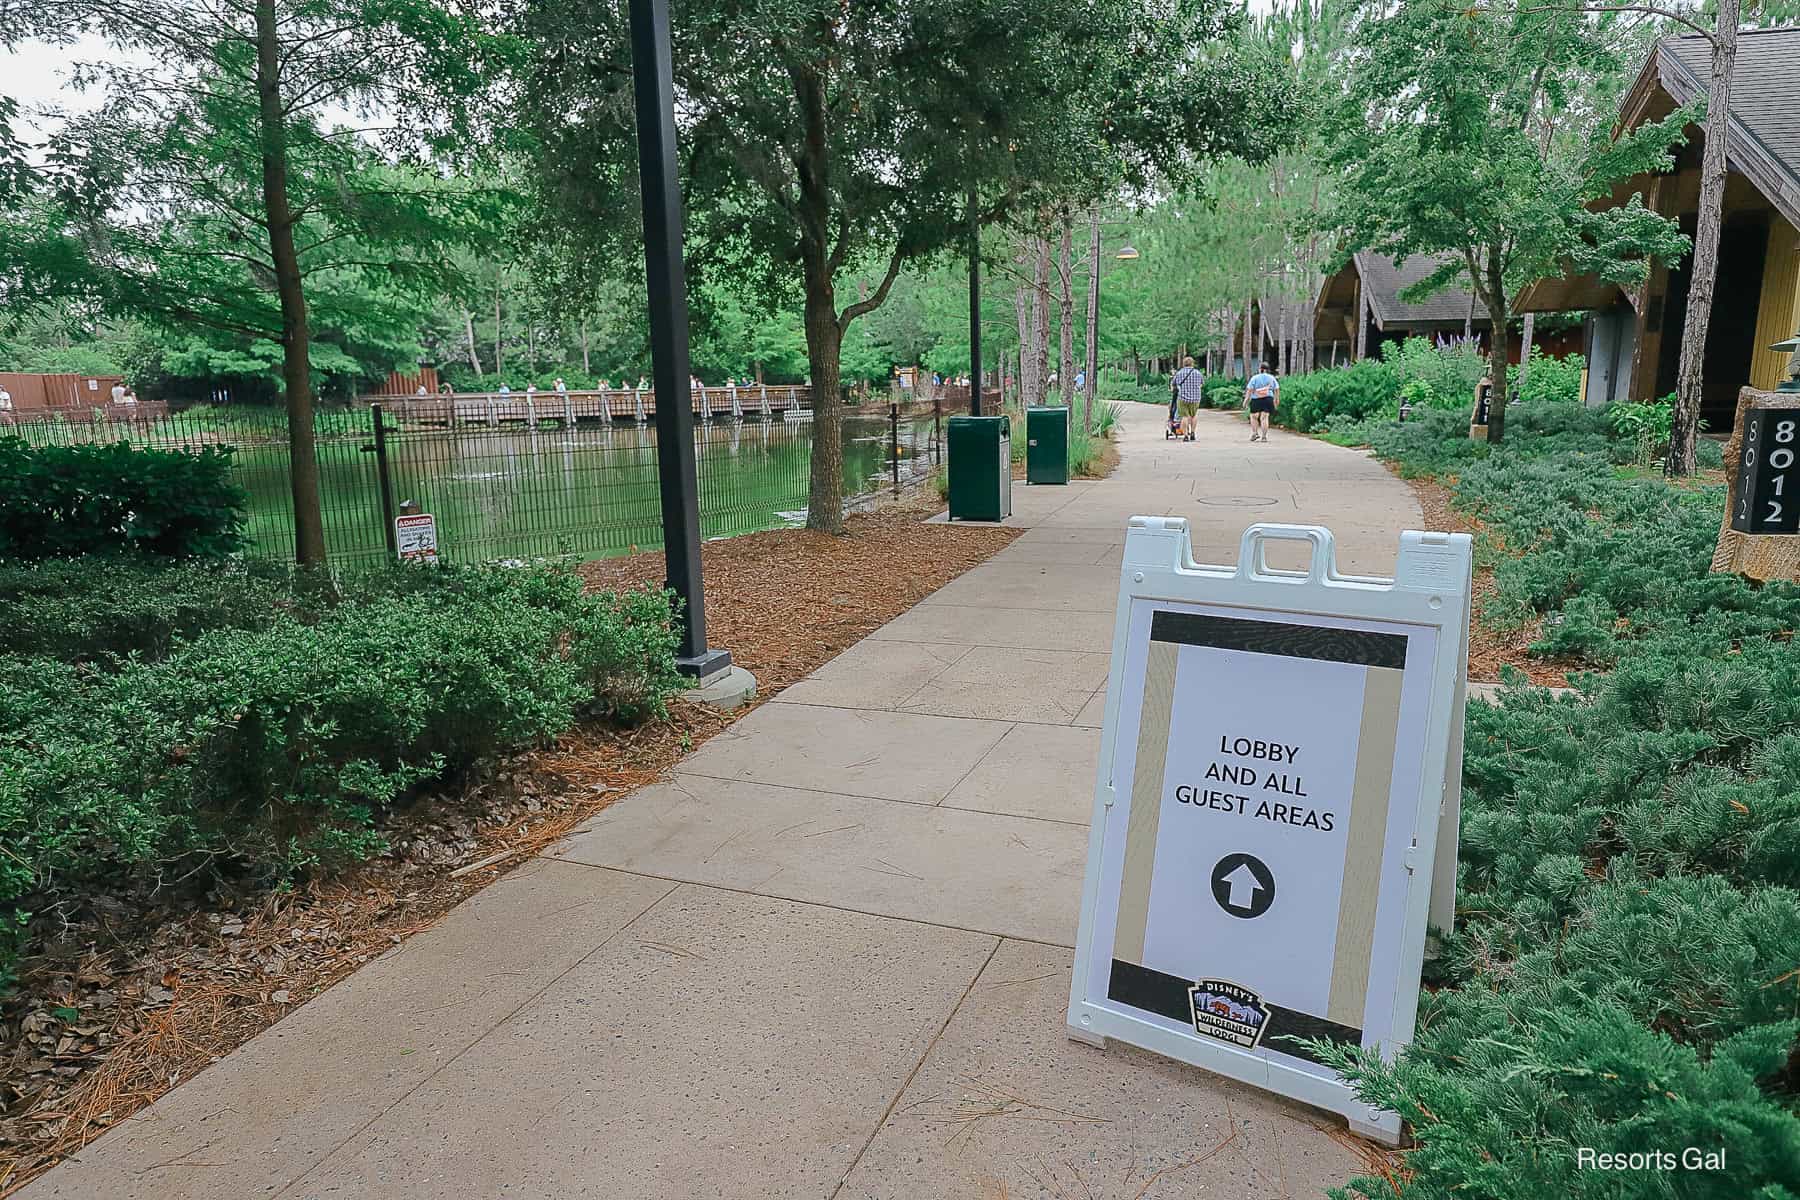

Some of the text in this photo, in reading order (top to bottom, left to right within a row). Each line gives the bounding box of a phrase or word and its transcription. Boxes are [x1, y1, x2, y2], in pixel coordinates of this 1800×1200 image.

[1763, 420, 1795, 522] 8012
[405, 518, 432, 526] DANGER
[1220, 735, 1299, 764] LOBBY
[1205, 762, 1307, 797] AND ALL
[1176, 785, 1334, 832] GUEST AREAS
[1207, 983, 1254, 1002] DISNEY'S
[1200, 1013, 1254, 1036] WILDERNESS
[1209, 1027, 1238, 1041] LODGE
